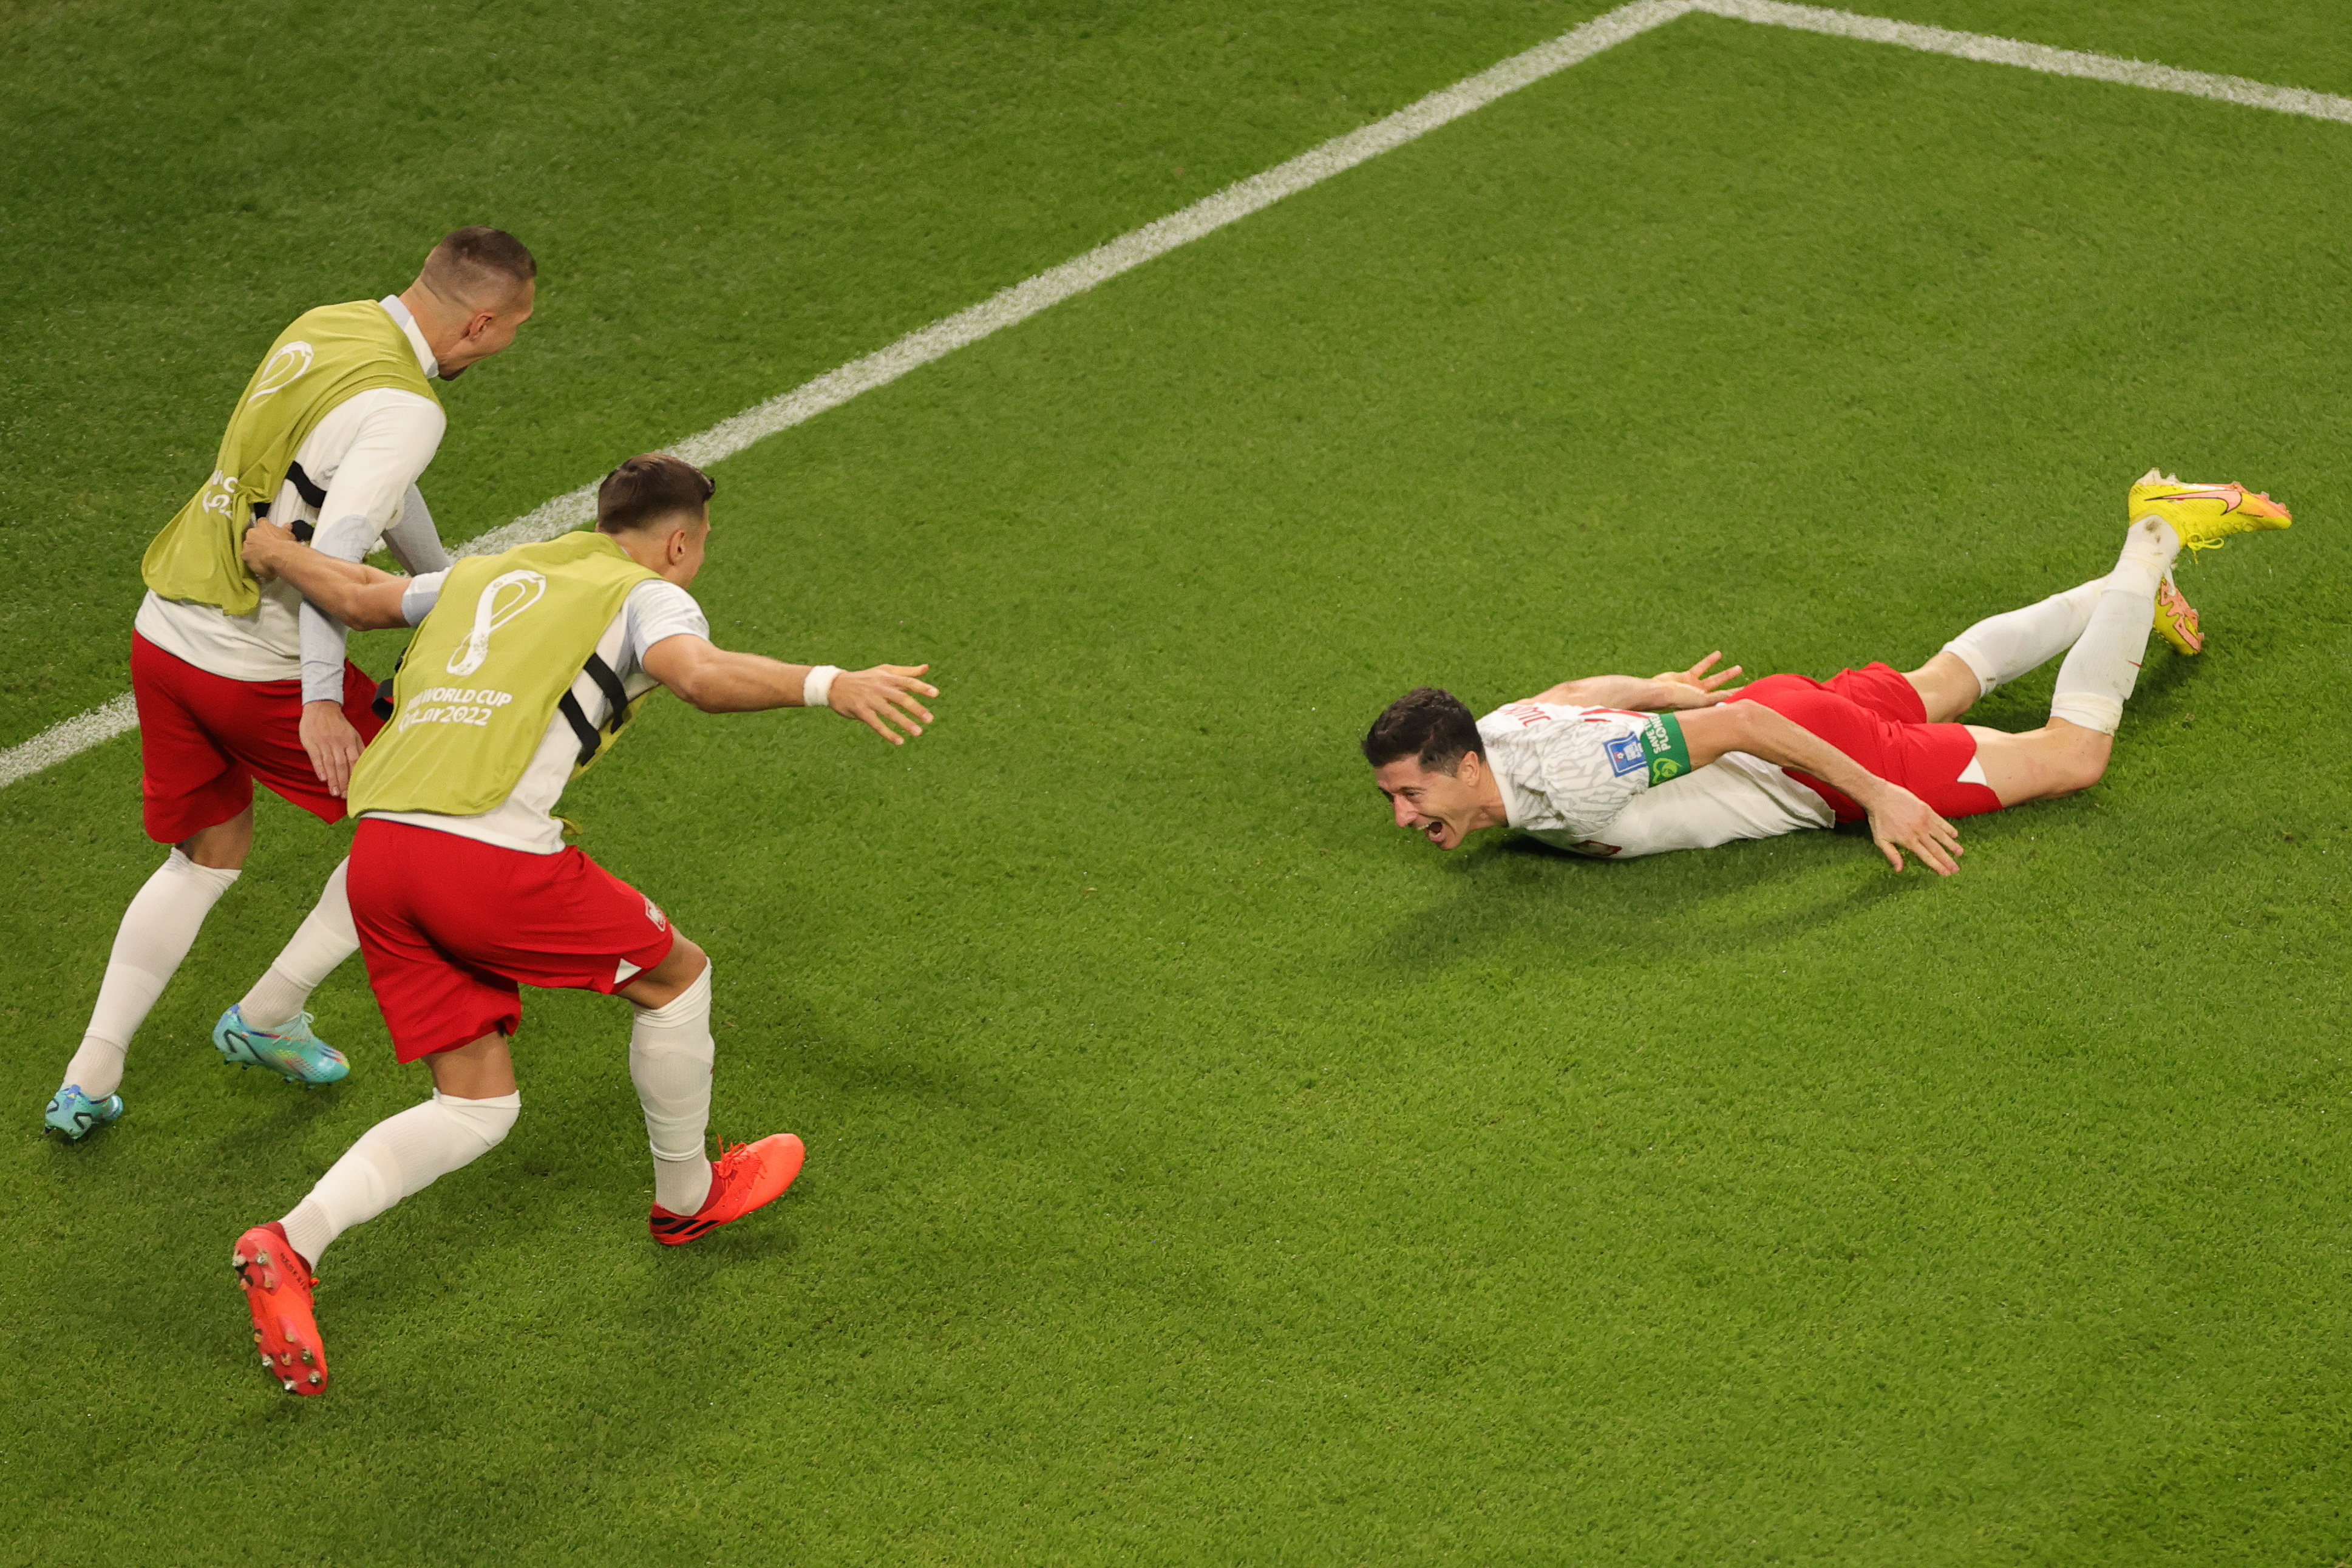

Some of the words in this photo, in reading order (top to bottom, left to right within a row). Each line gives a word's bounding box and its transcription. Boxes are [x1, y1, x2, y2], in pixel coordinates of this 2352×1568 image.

[421, 687, 476, 703] WORLD
[476, 688, 513, 707] CUP
[1645, 728, 1662, 754] SAVE
